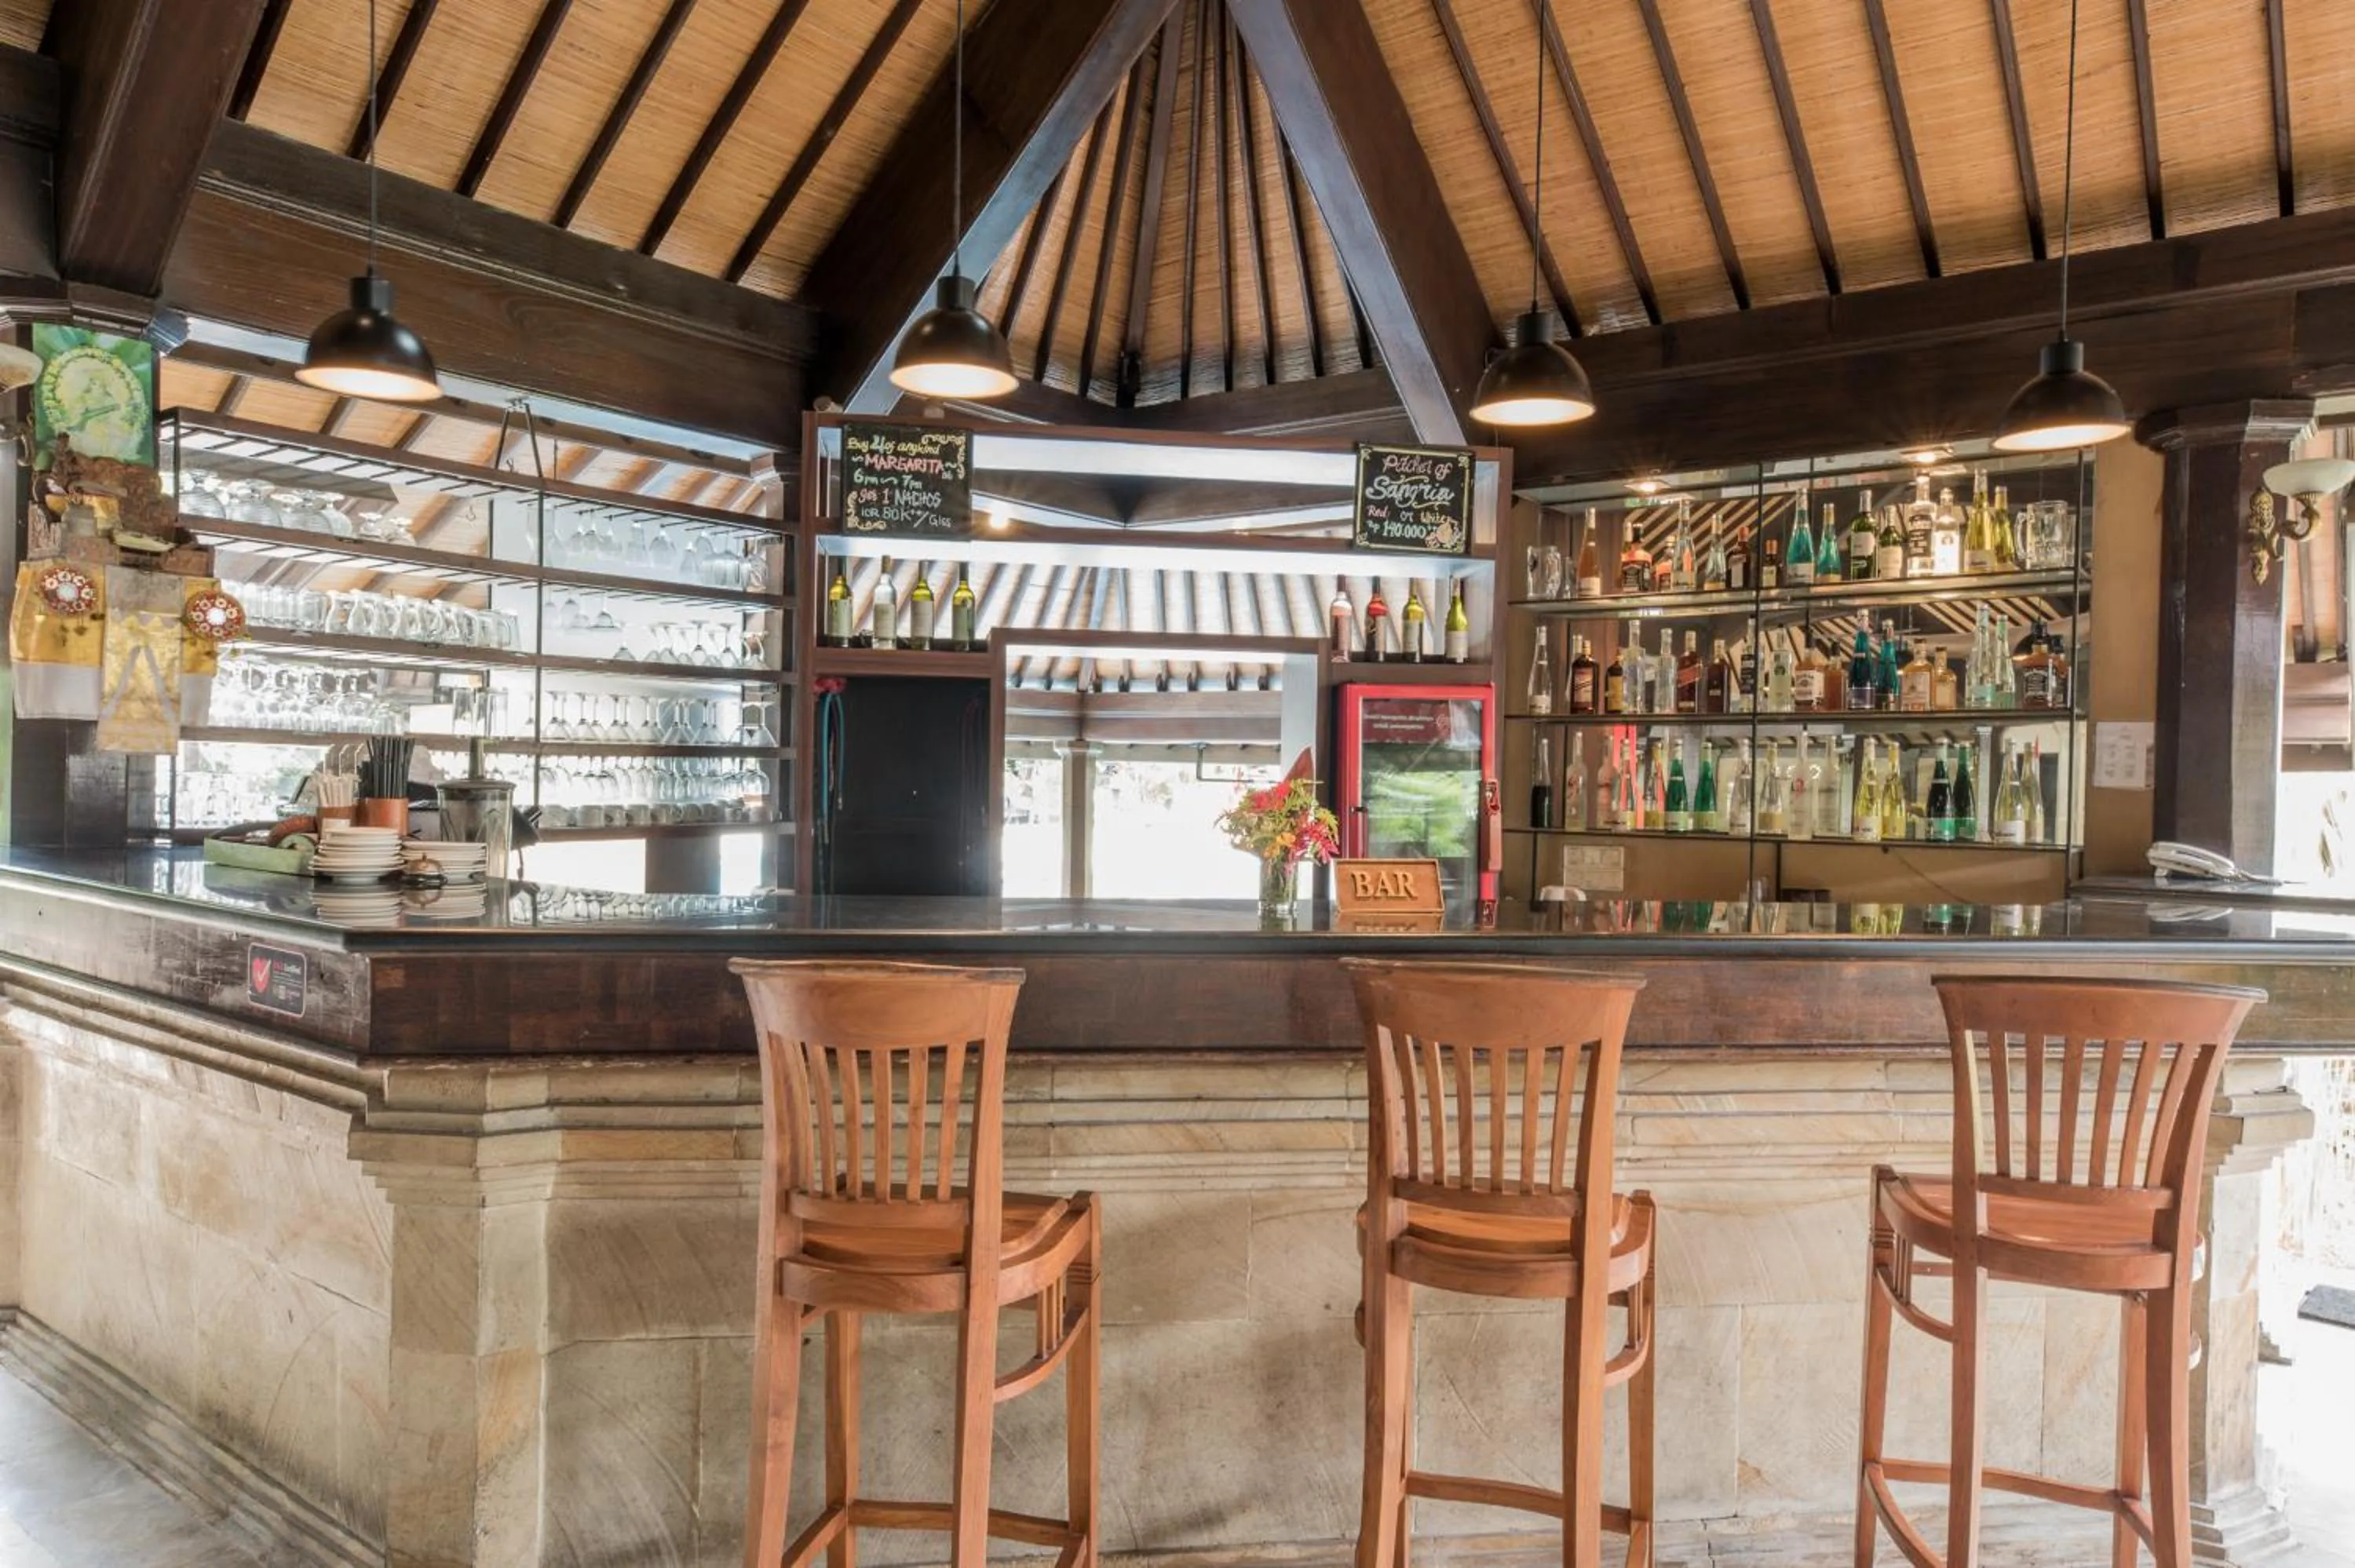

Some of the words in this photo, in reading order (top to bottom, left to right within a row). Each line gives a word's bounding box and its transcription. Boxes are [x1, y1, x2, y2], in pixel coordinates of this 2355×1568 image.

[848, 437, 869, 453] Buy
[864, 454, 944, 474] MARGARITA
[1434, 461, 1453, 480] of
[853, 468, 878, 486] 6pm
[901, 475, 922, 490] 7pm
[894, 489, 942, 509] NACHOS
[1365, 475, 1455, 508] Sangria
[1367, 505, 1388, 518] Red
[1400, 510, 1413, 521] or
[1351, 870, 1418, 900] BAR
